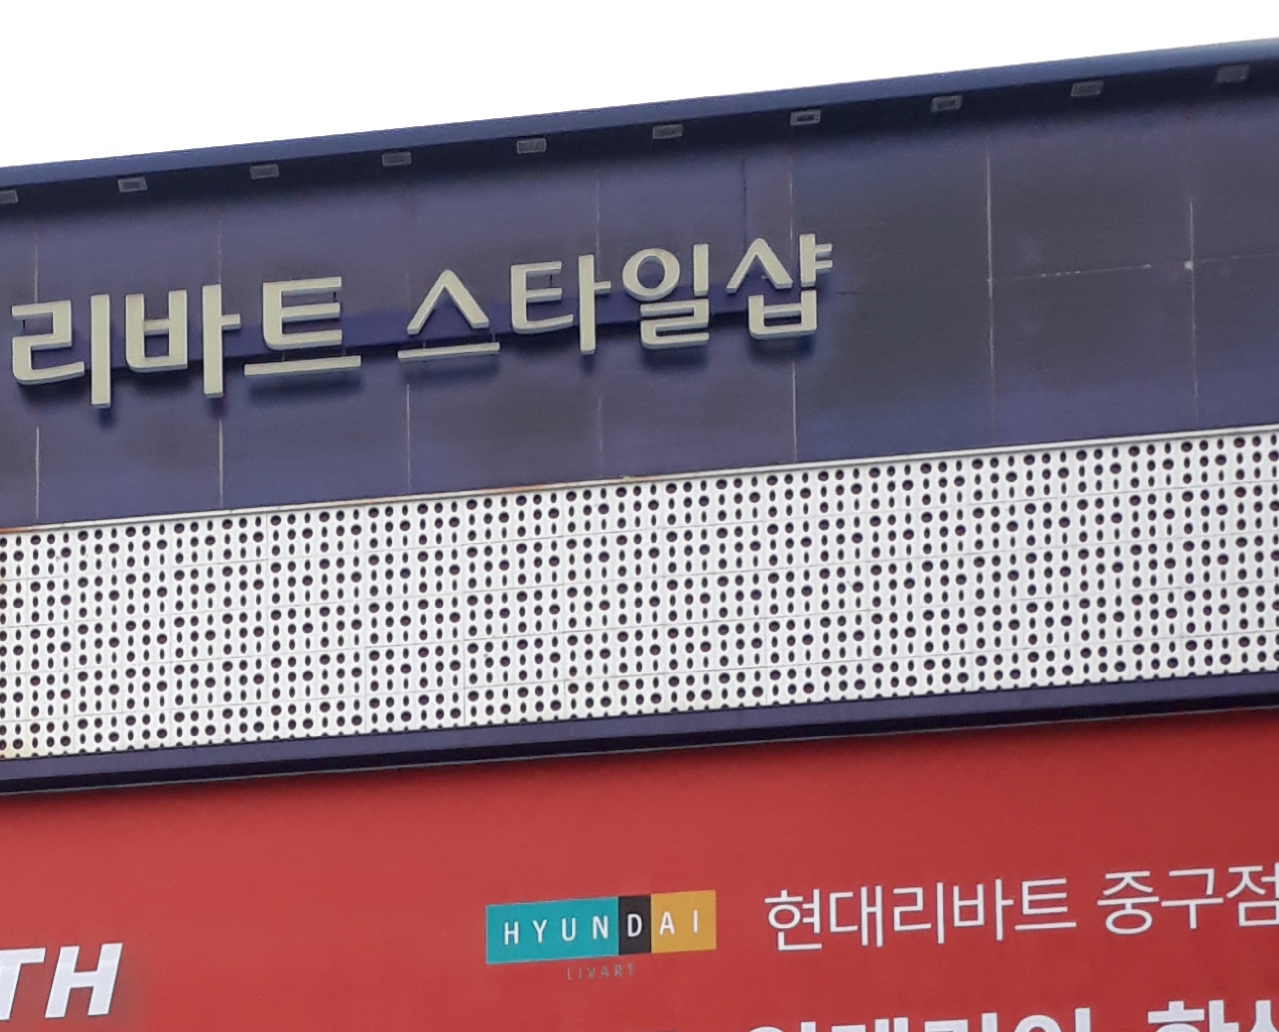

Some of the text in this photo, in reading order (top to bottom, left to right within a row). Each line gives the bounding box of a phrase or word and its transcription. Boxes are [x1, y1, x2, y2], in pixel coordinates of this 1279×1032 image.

[10, 232, 834, 410] 리바트 스타일샵
[503, 909, 700, 946] HYUNDAI
[763, 862, 1279, 952] 현대리바트 중구점
[566, 963, 635, 981] LIVART
